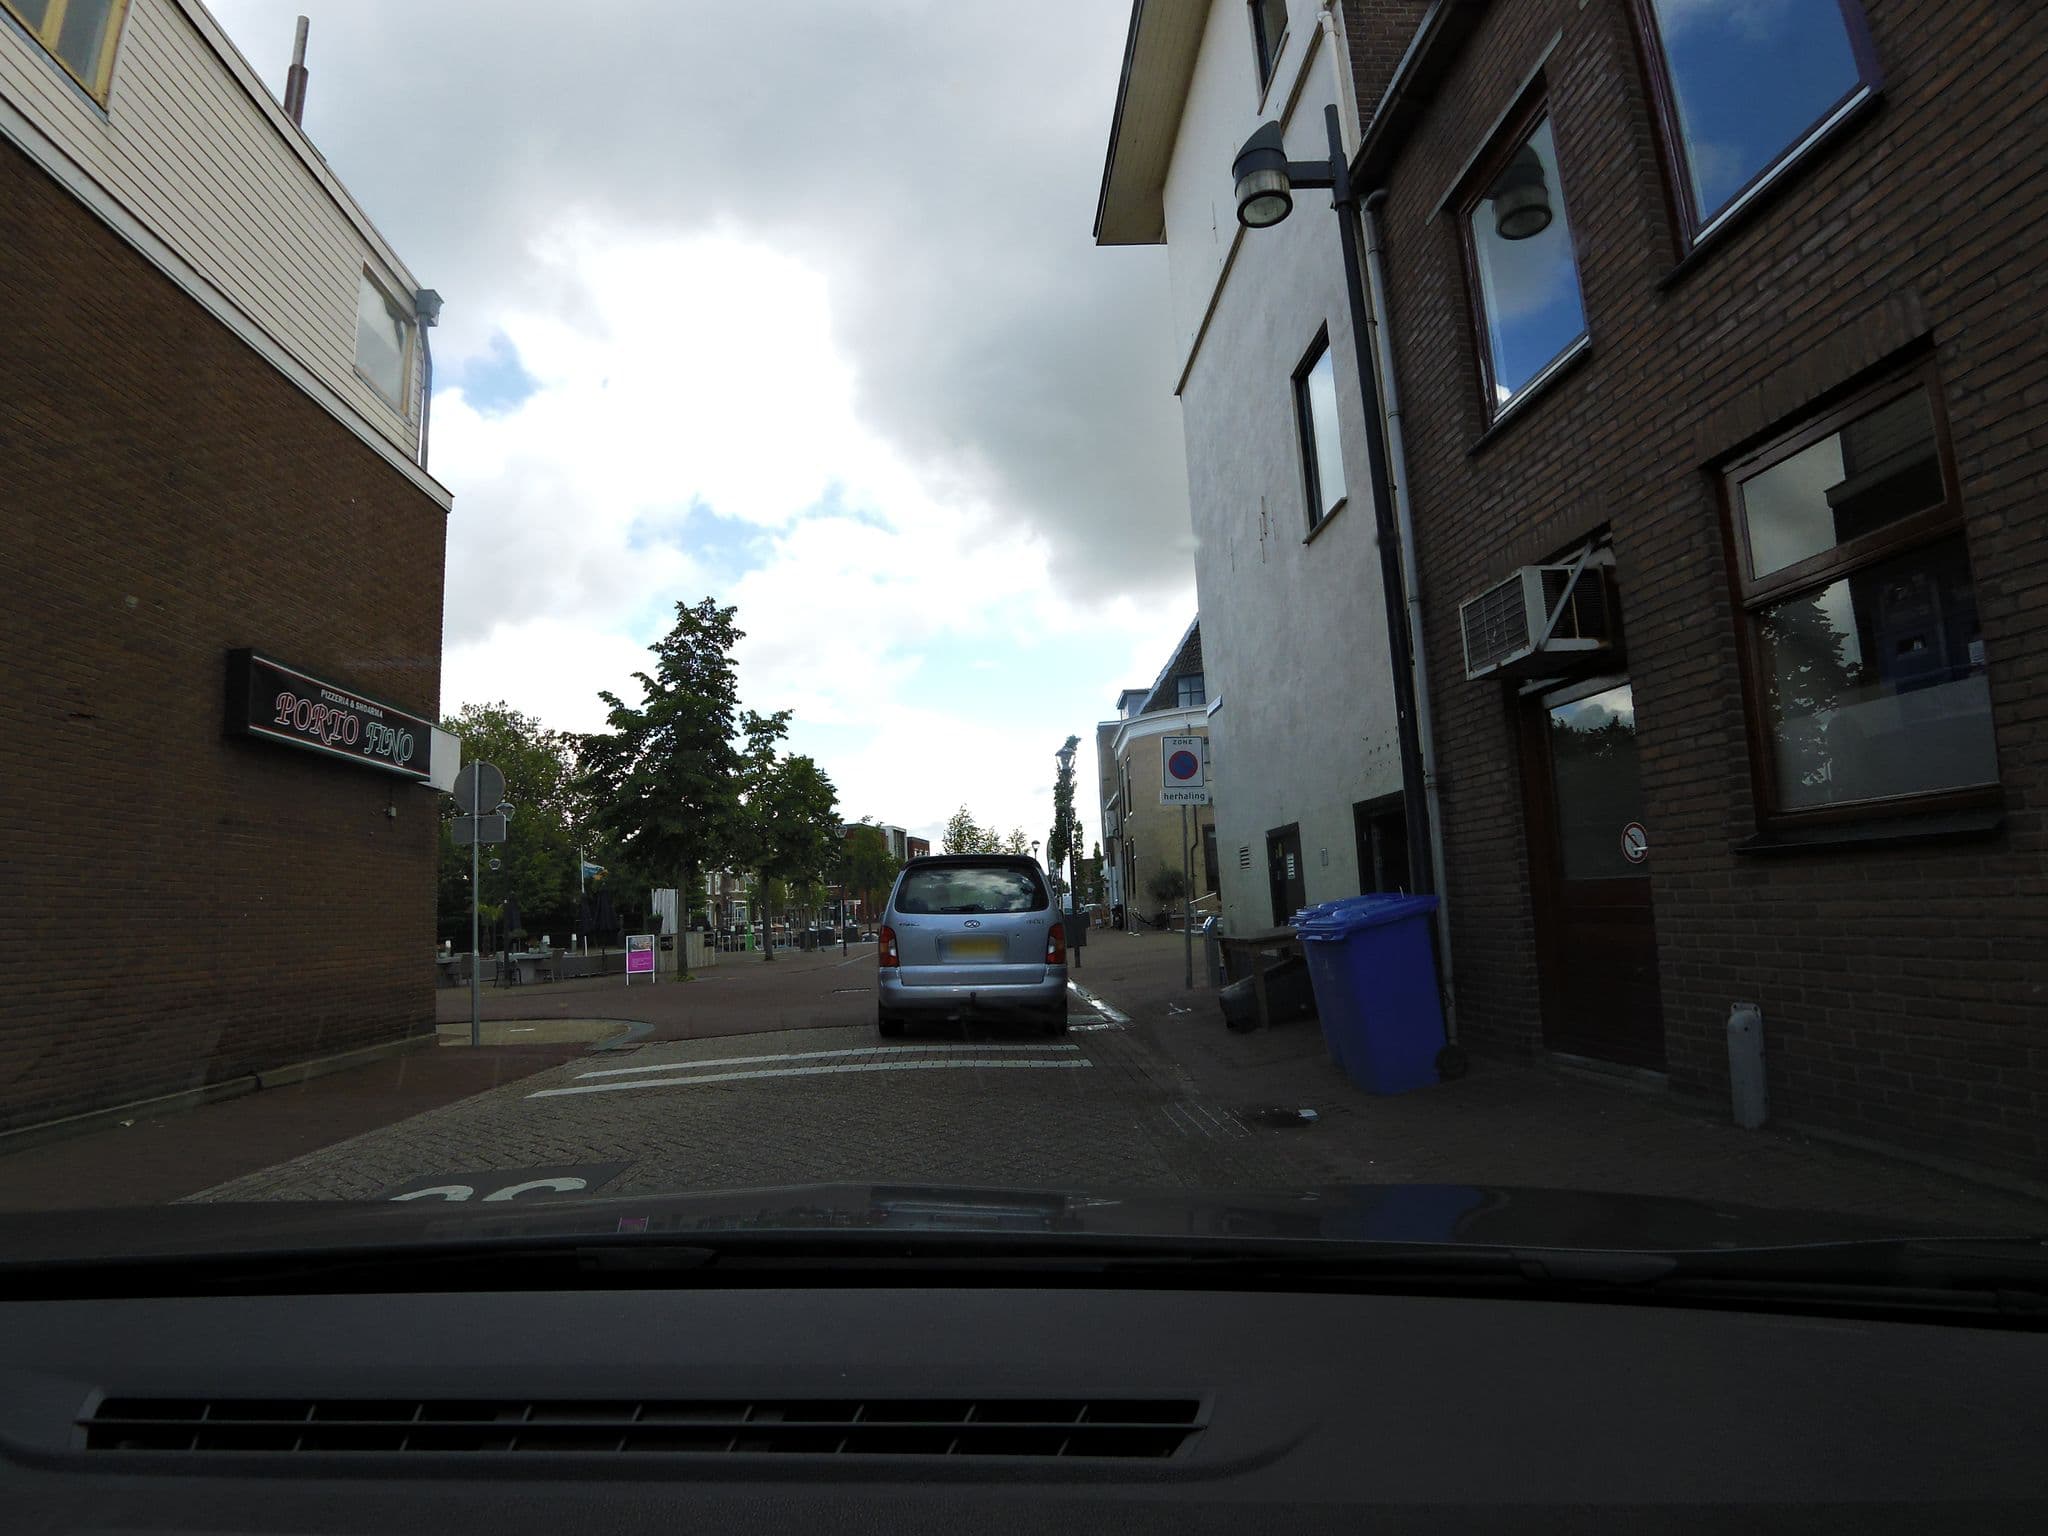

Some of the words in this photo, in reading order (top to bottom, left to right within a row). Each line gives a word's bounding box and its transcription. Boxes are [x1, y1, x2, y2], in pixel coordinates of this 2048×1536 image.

[321, 689, 349, 707] PIZZERIA
[349, 700, 355, 708] &
[355, 702, 383, 718] SHOARMA
[274, 692, 359, 745] PORTO
[364, 722, 414, 766] FINO
[1163, 792, 1205, 801] herhaling
